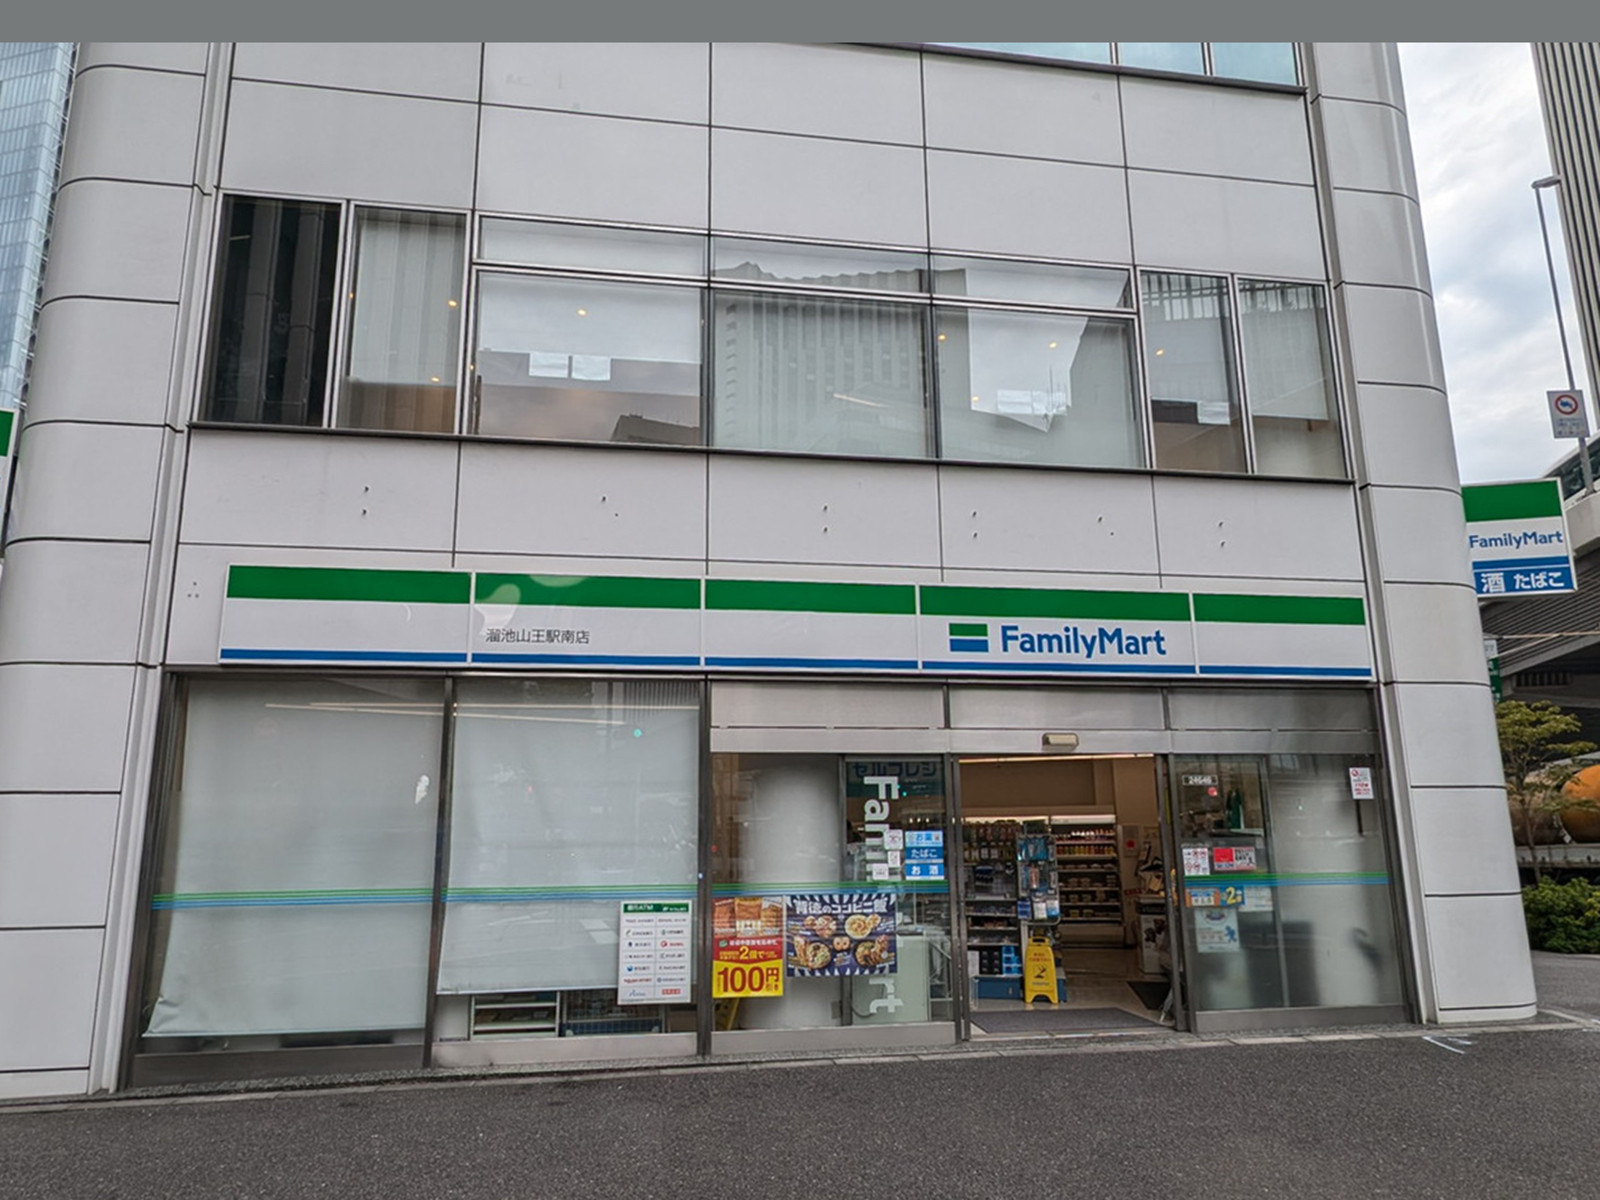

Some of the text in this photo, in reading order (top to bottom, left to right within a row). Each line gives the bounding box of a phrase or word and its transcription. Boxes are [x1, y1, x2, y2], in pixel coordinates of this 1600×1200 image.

[1469, 530, 1563, 550] FamilyMart
[1481, 571, 1566, 593] 酒 たばこ
[486, 628, 590, 645] 溜池山王駅南店
[1001, 625, 1167, 659] FamilyMart
[911, 848, 938, 859] たばこ
[718, 966, 780, 993] 100円
